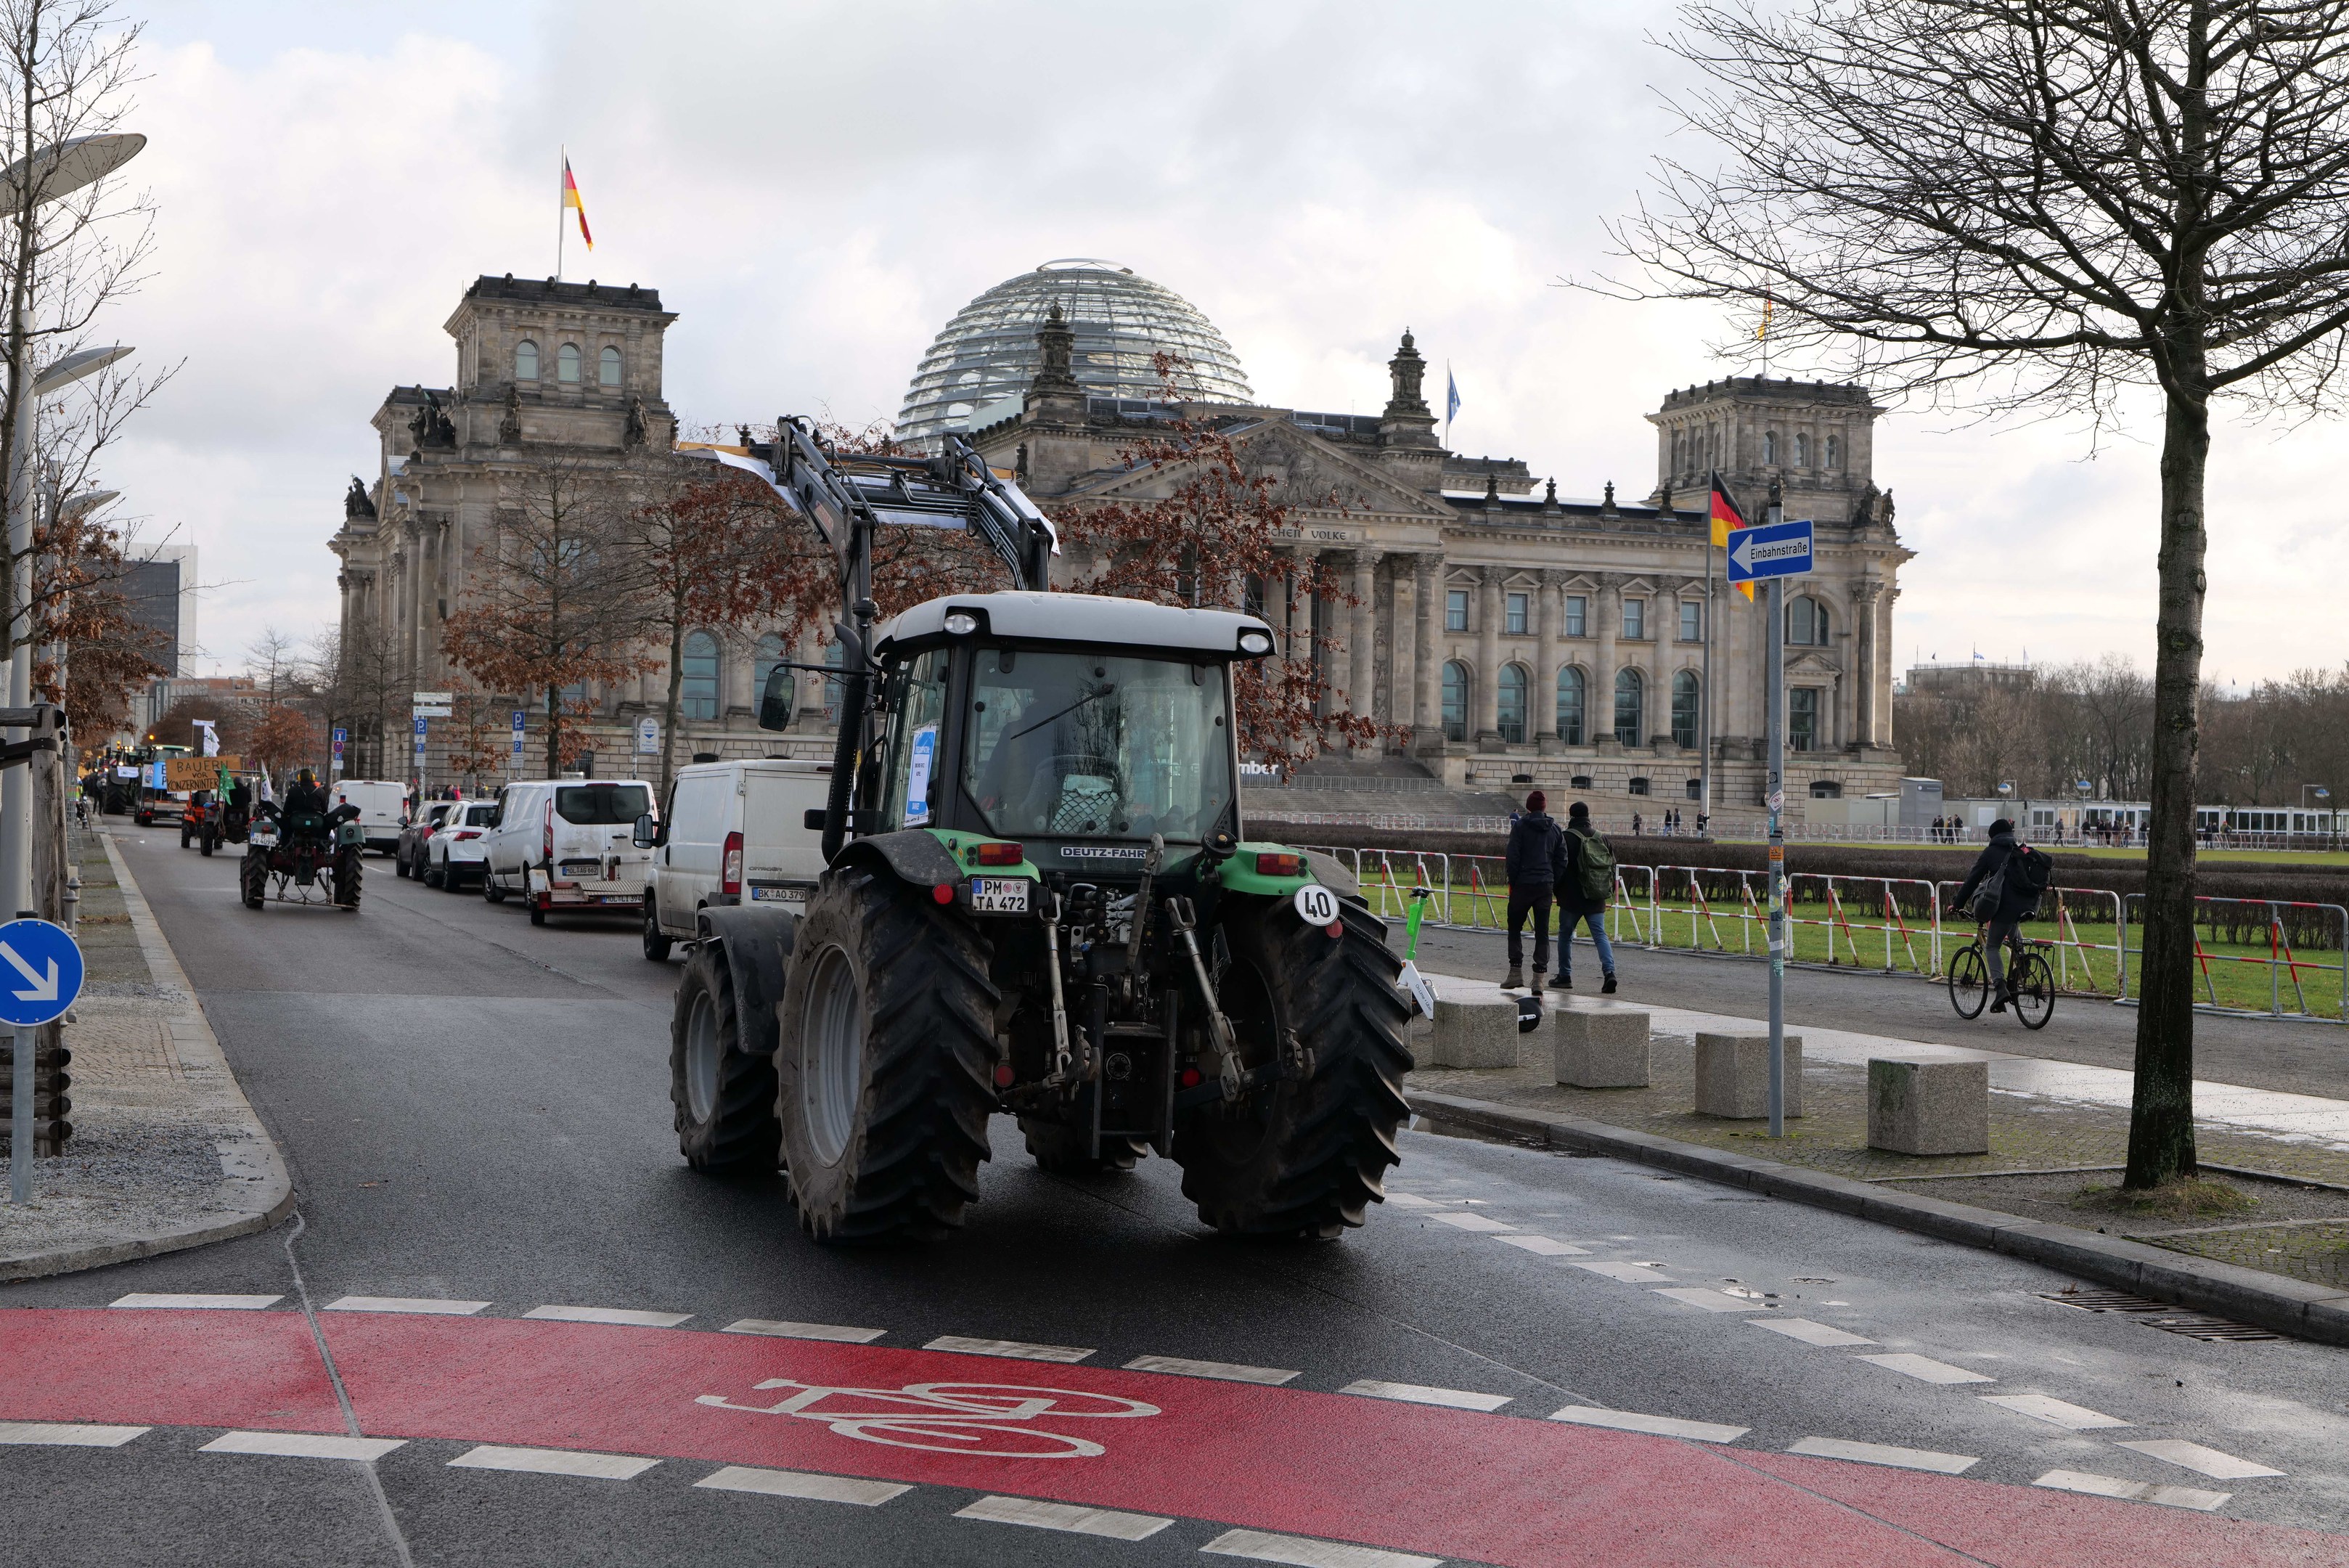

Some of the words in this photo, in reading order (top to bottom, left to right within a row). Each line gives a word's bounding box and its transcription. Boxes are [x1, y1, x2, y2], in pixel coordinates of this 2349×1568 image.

[1311, 530, 1347, 540] VOLKE
[1750, 542, 1807, 560] Einbahnstraße
[176, 760, 229, 773] BAUERN
[1062, 848, 1146, 858] DEUTZ-FAHR
[758, 889, 769, 898] BK
[788, 890, 804, 899] 379
[984, 881, 1002, 895] PM
[976, 896, 994, 910] TA
[1000, 897, 1025, 910] 472
[1304, 891, 1331, 918] 40
